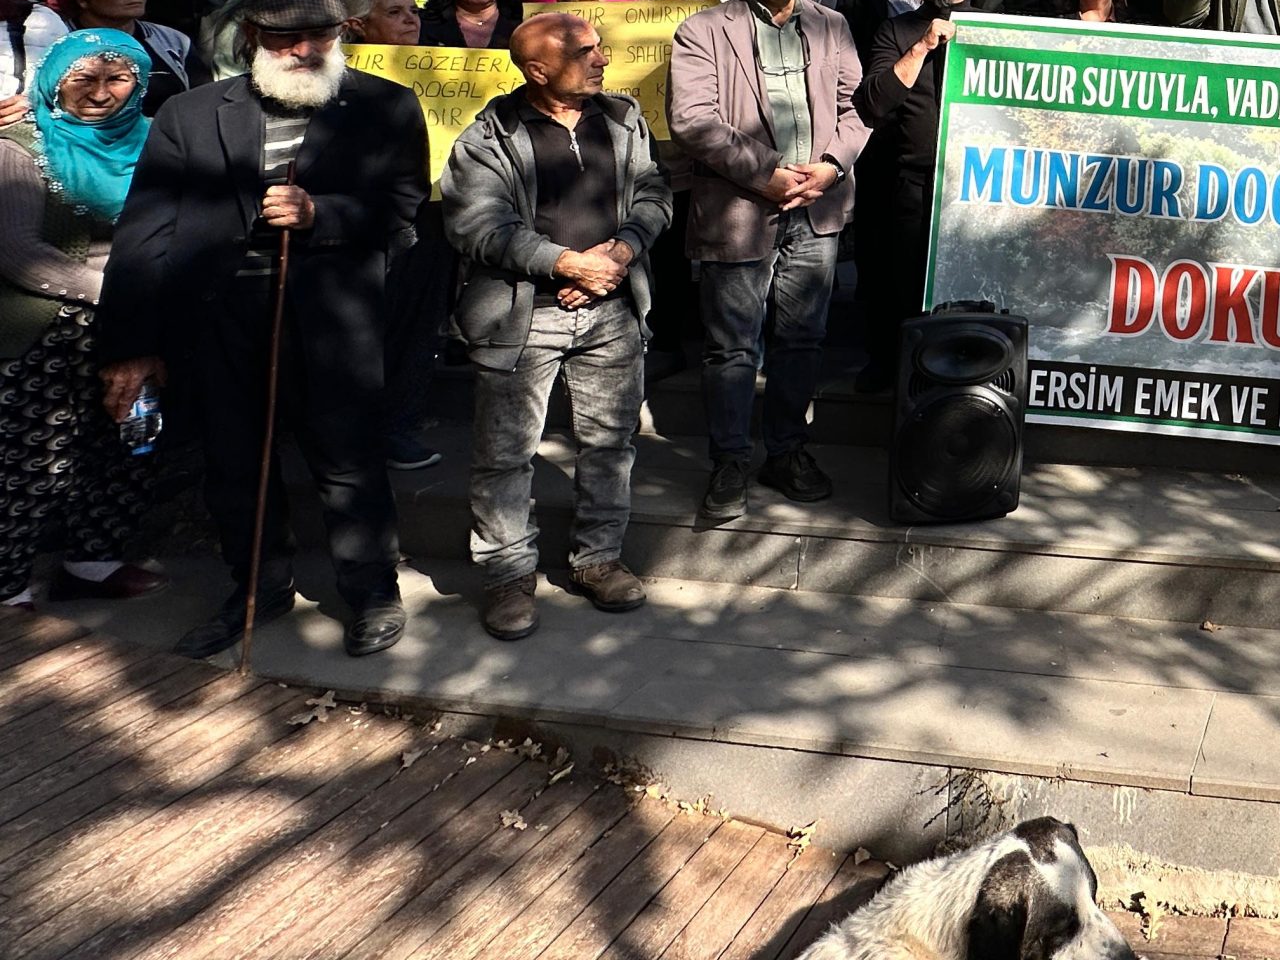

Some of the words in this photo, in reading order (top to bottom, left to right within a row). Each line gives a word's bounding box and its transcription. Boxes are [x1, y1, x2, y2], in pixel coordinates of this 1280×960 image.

[412, 78, 483, 99] DOĞAL
[962, 57, 1078, 105] MUNZUR
[1081, 66, 1218, 120] SUYUYLA,
[958, 145, 1185, 218] MUNZUR
[1028, 367, 1124, 413] ERSİM
[1134, 377, 1222, 421] EMEK
[1230, 385, 1269, 425] VE
